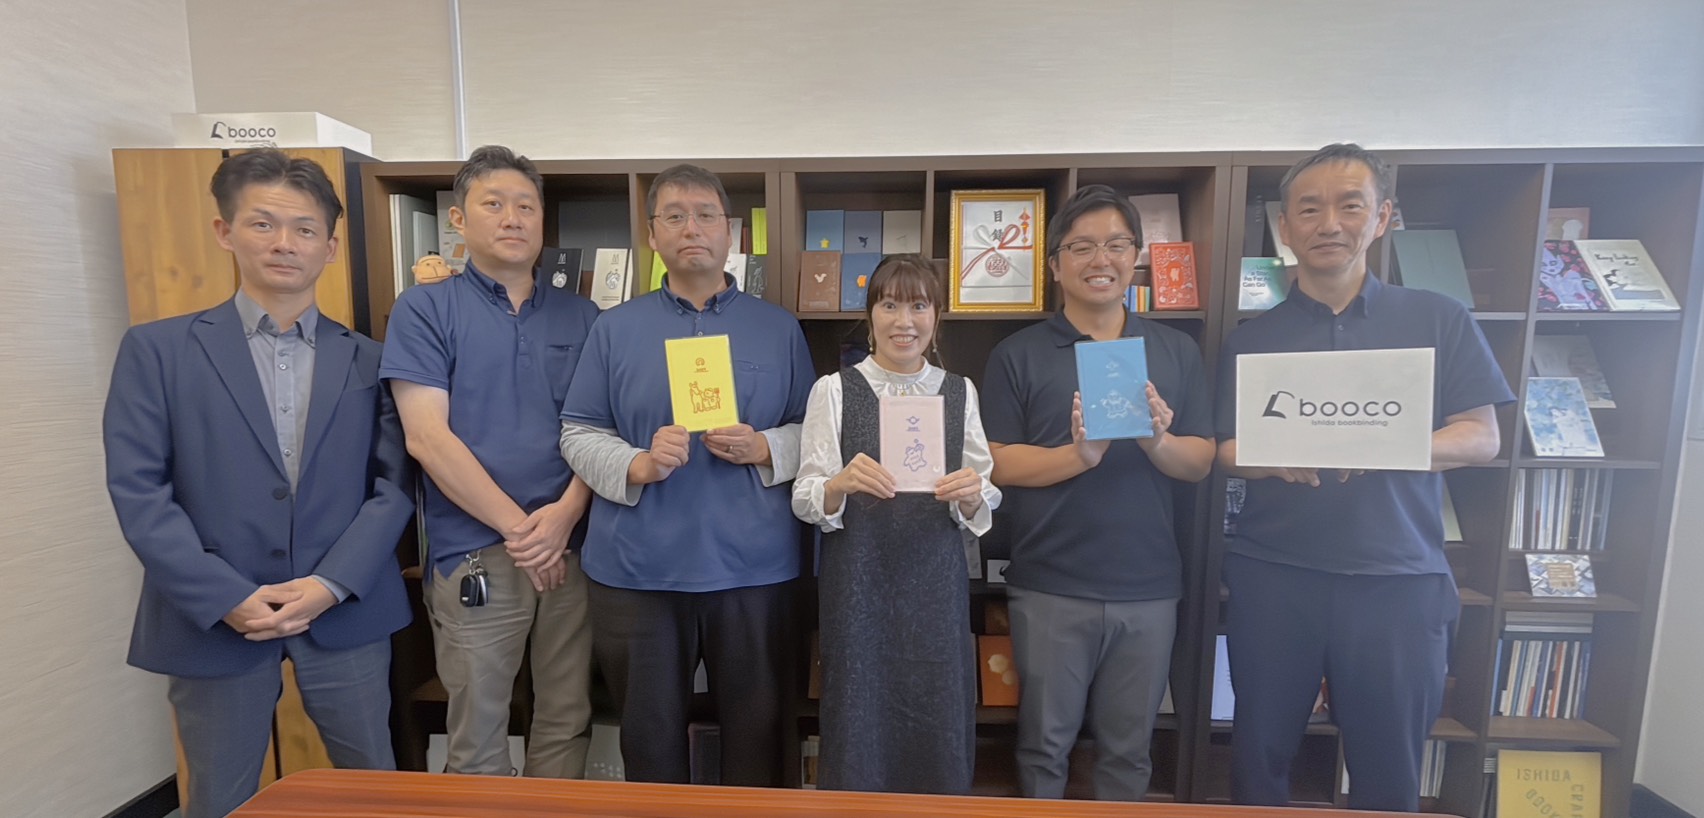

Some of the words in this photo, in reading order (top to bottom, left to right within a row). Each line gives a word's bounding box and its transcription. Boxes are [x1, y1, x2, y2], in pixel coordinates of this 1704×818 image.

[228, 126, 276, 138] booco
[1299, 398, 1402, 417] booco
[1337, 419, 1389, 427] bookbinding
[1516, 768, 1572, 782] ISHIDA
